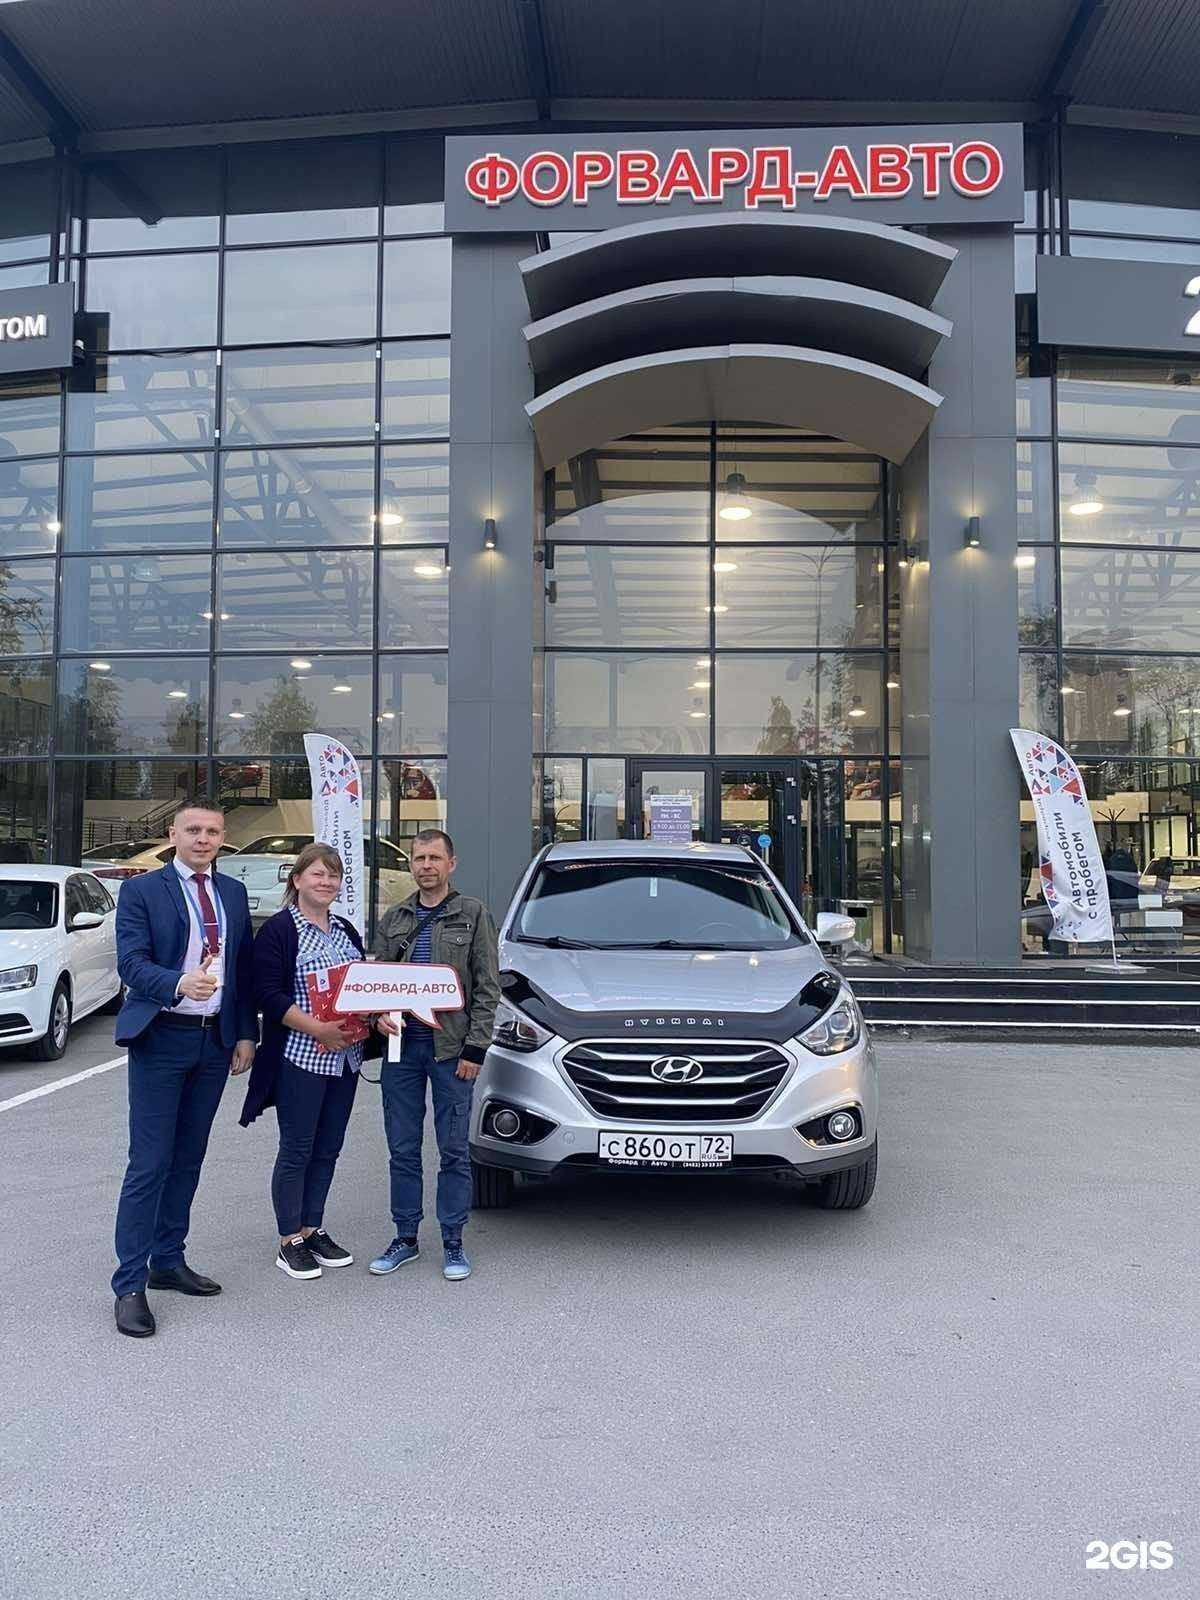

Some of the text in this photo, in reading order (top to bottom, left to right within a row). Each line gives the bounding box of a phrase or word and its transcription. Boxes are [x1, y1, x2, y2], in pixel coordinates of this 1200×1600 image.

[465, 141, 1004, 208] ФОРВАРД-АВТО
[343, 830, 355, 903] пробегом
[1053, 812, 1083, 907] Автомобили
[1071, 831, 1098, 907] пробегом
[344, 983, 457, 994] #ФОРВАРД-АВТО
[703, 1137, 725, 1154] 72
